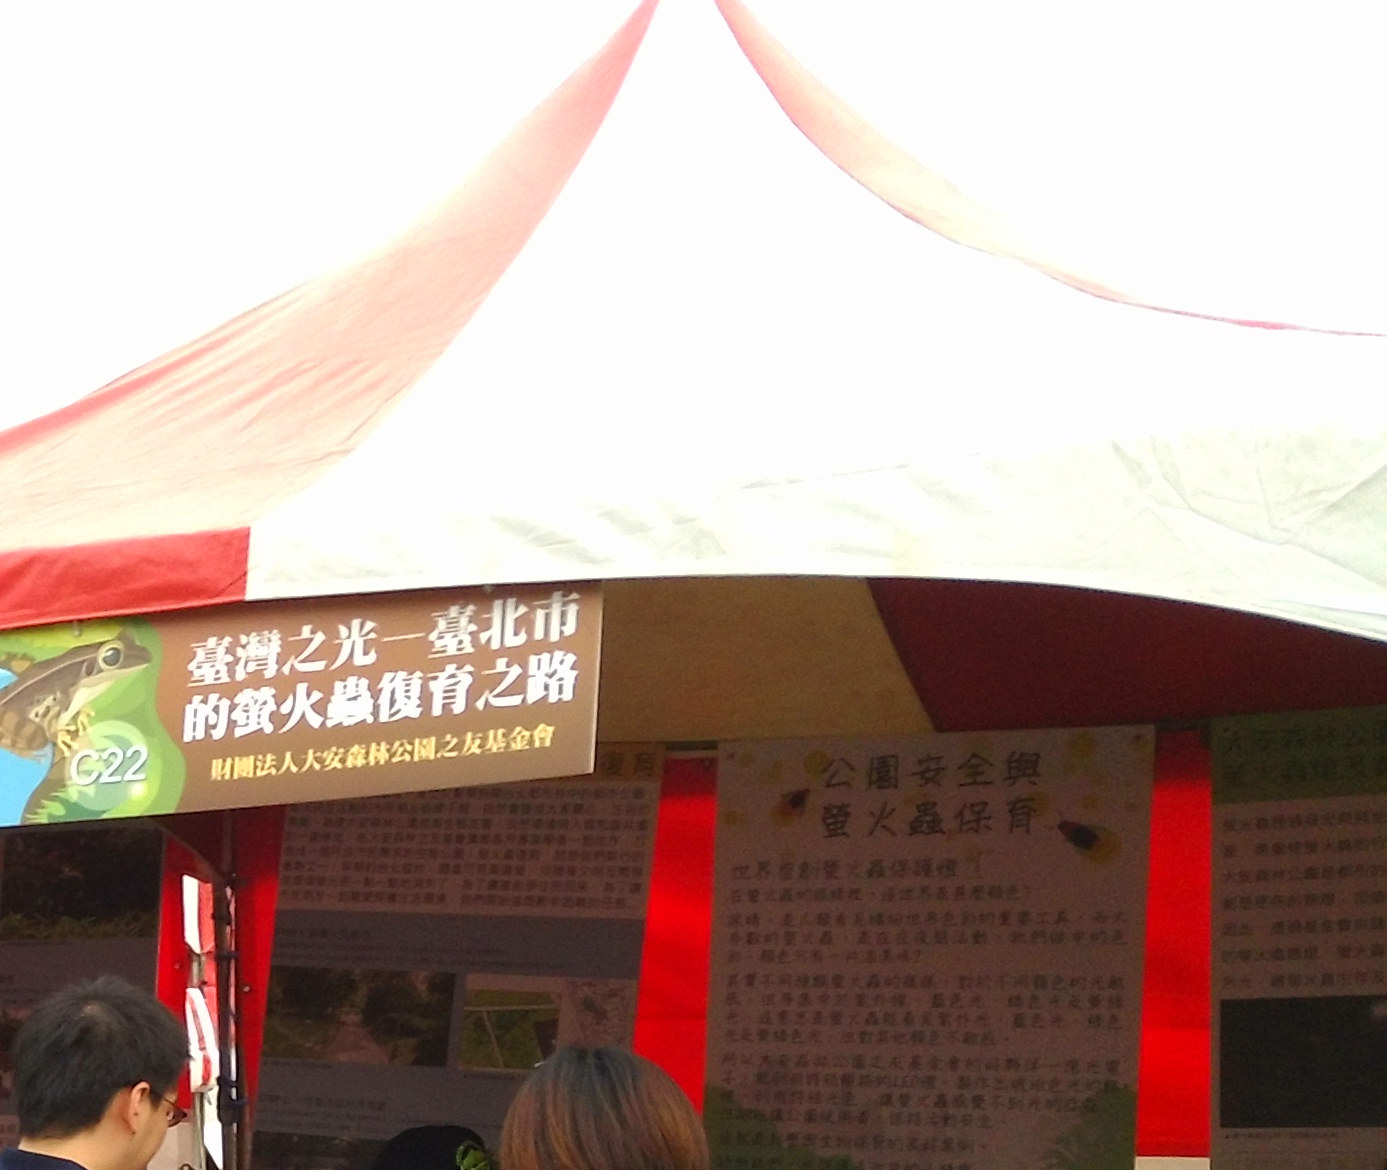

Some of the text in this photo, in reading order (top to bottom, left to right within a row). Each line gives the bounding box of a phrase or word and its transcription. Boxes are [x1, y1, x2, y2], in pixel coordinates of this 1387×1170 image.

[183, 650, 578, 744] 的螢火蟲復育之路
[69, 745, 149, 787] C22
[210, 723, 556, 783] 財團法人大安森林公園之友基金會
[822, 751, 1043, 791] 公園安全與
[821, 797, 1036, 839] 螢火蟲保育
